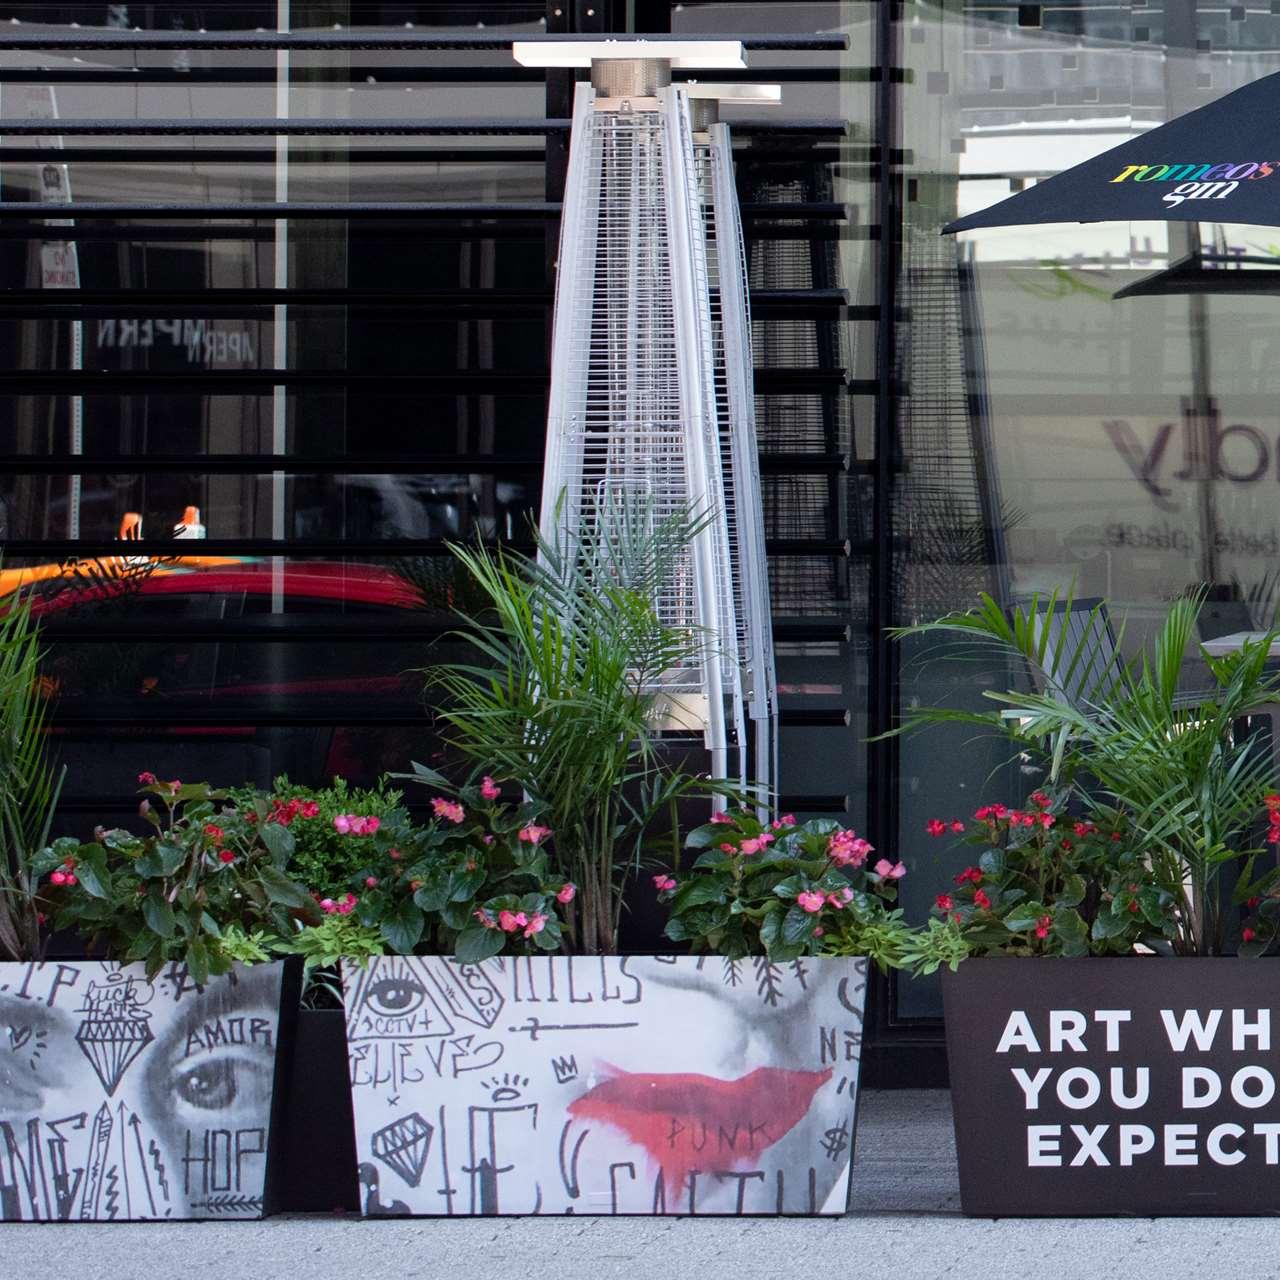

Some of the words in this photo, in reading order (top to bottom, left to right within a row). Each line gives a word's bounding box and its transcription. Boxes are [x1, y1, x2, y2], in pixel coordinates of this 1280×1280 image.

[184, 1016, 272, 1058] AMOR
[996, 1010, 1131, 1053] ART
[1010, 1066, 1150, 1110] YOU
